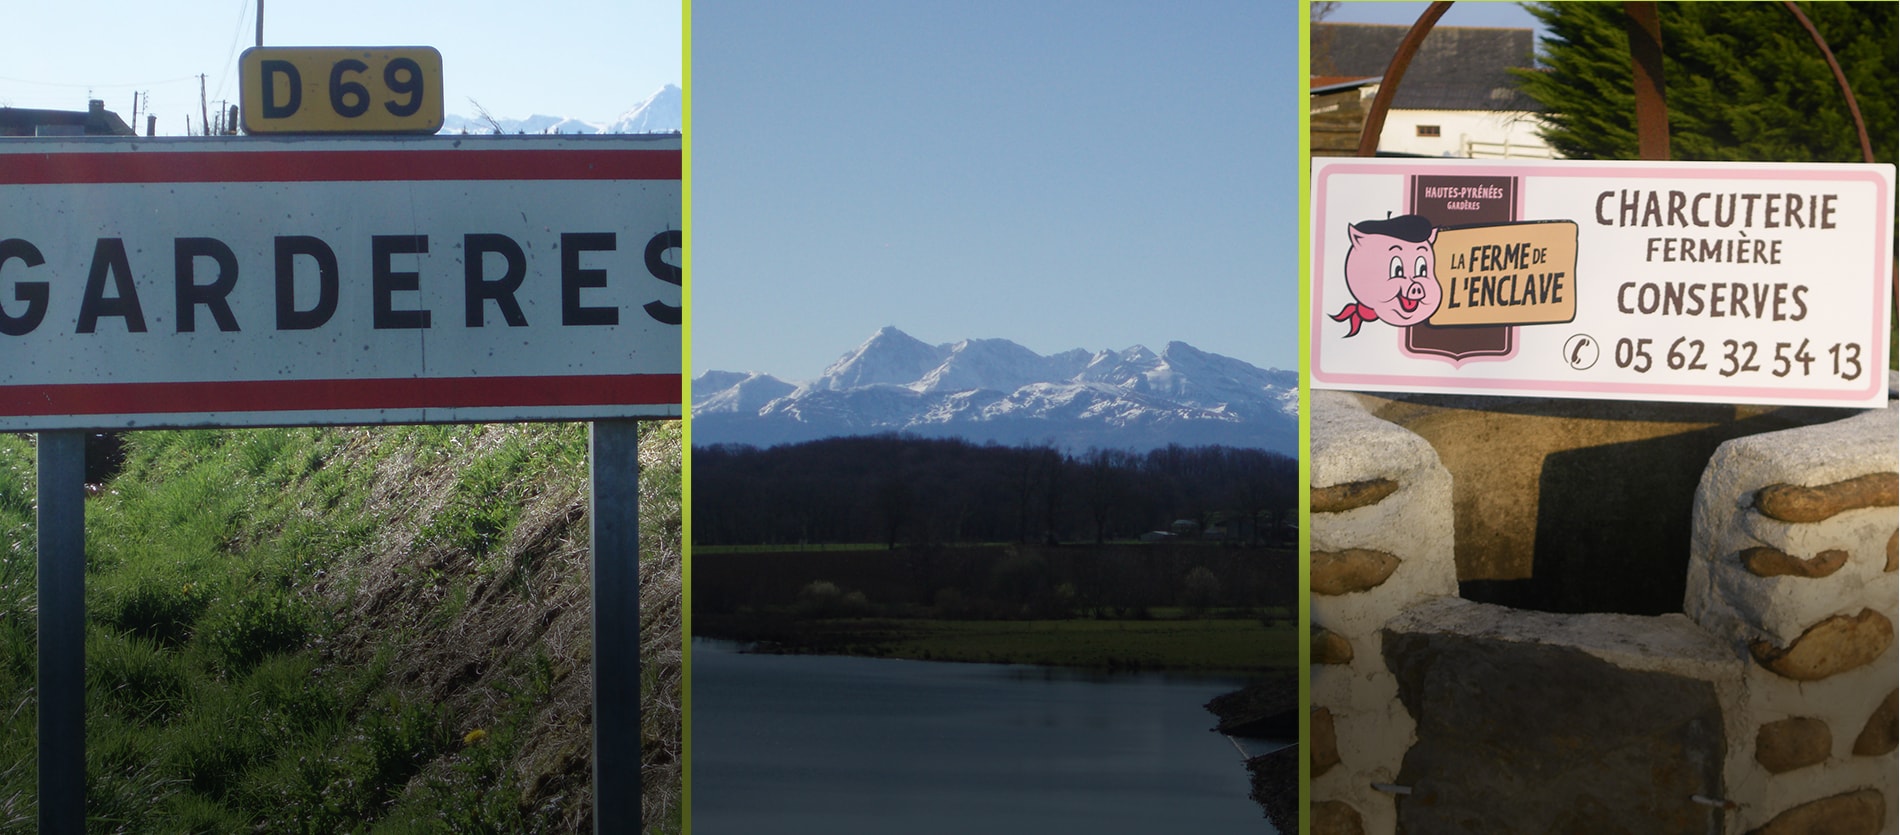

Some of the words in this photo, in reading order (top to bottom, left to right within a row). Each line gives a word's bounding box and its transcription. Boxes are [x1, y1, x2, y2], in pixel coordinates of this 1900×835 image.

[261, 60, 302, 119] D
[329, 57, 424, 118] 69
[1425, 184, 1503, 199] HAUTES-PYRÉNÉES
[1447, 200, 1480, 210] GARDÈRES
[1595, 189, 1838, 229] CHARCUTERIE
[1450, 253, 1465, 270] LA
[1468, 243, 1531, 273] FERME
[1532, 247, 1547, 265] DE
[1646, 231, 1782, 265] FERMIÈRE
[0, 229, 682, 336] GARDERES
[1448, 271, 1565, 309] L'ENCLAVE
[1617, 282, 1809, 322] CONSERVES
[1615, 338, 1653, 374] 05
[1667, 336, 1708, 371] 62
[1719, 340, 1761, 378] 32
[1772, 339, 1816, 378] 54
[1829, 343, 1862, 381] 13
